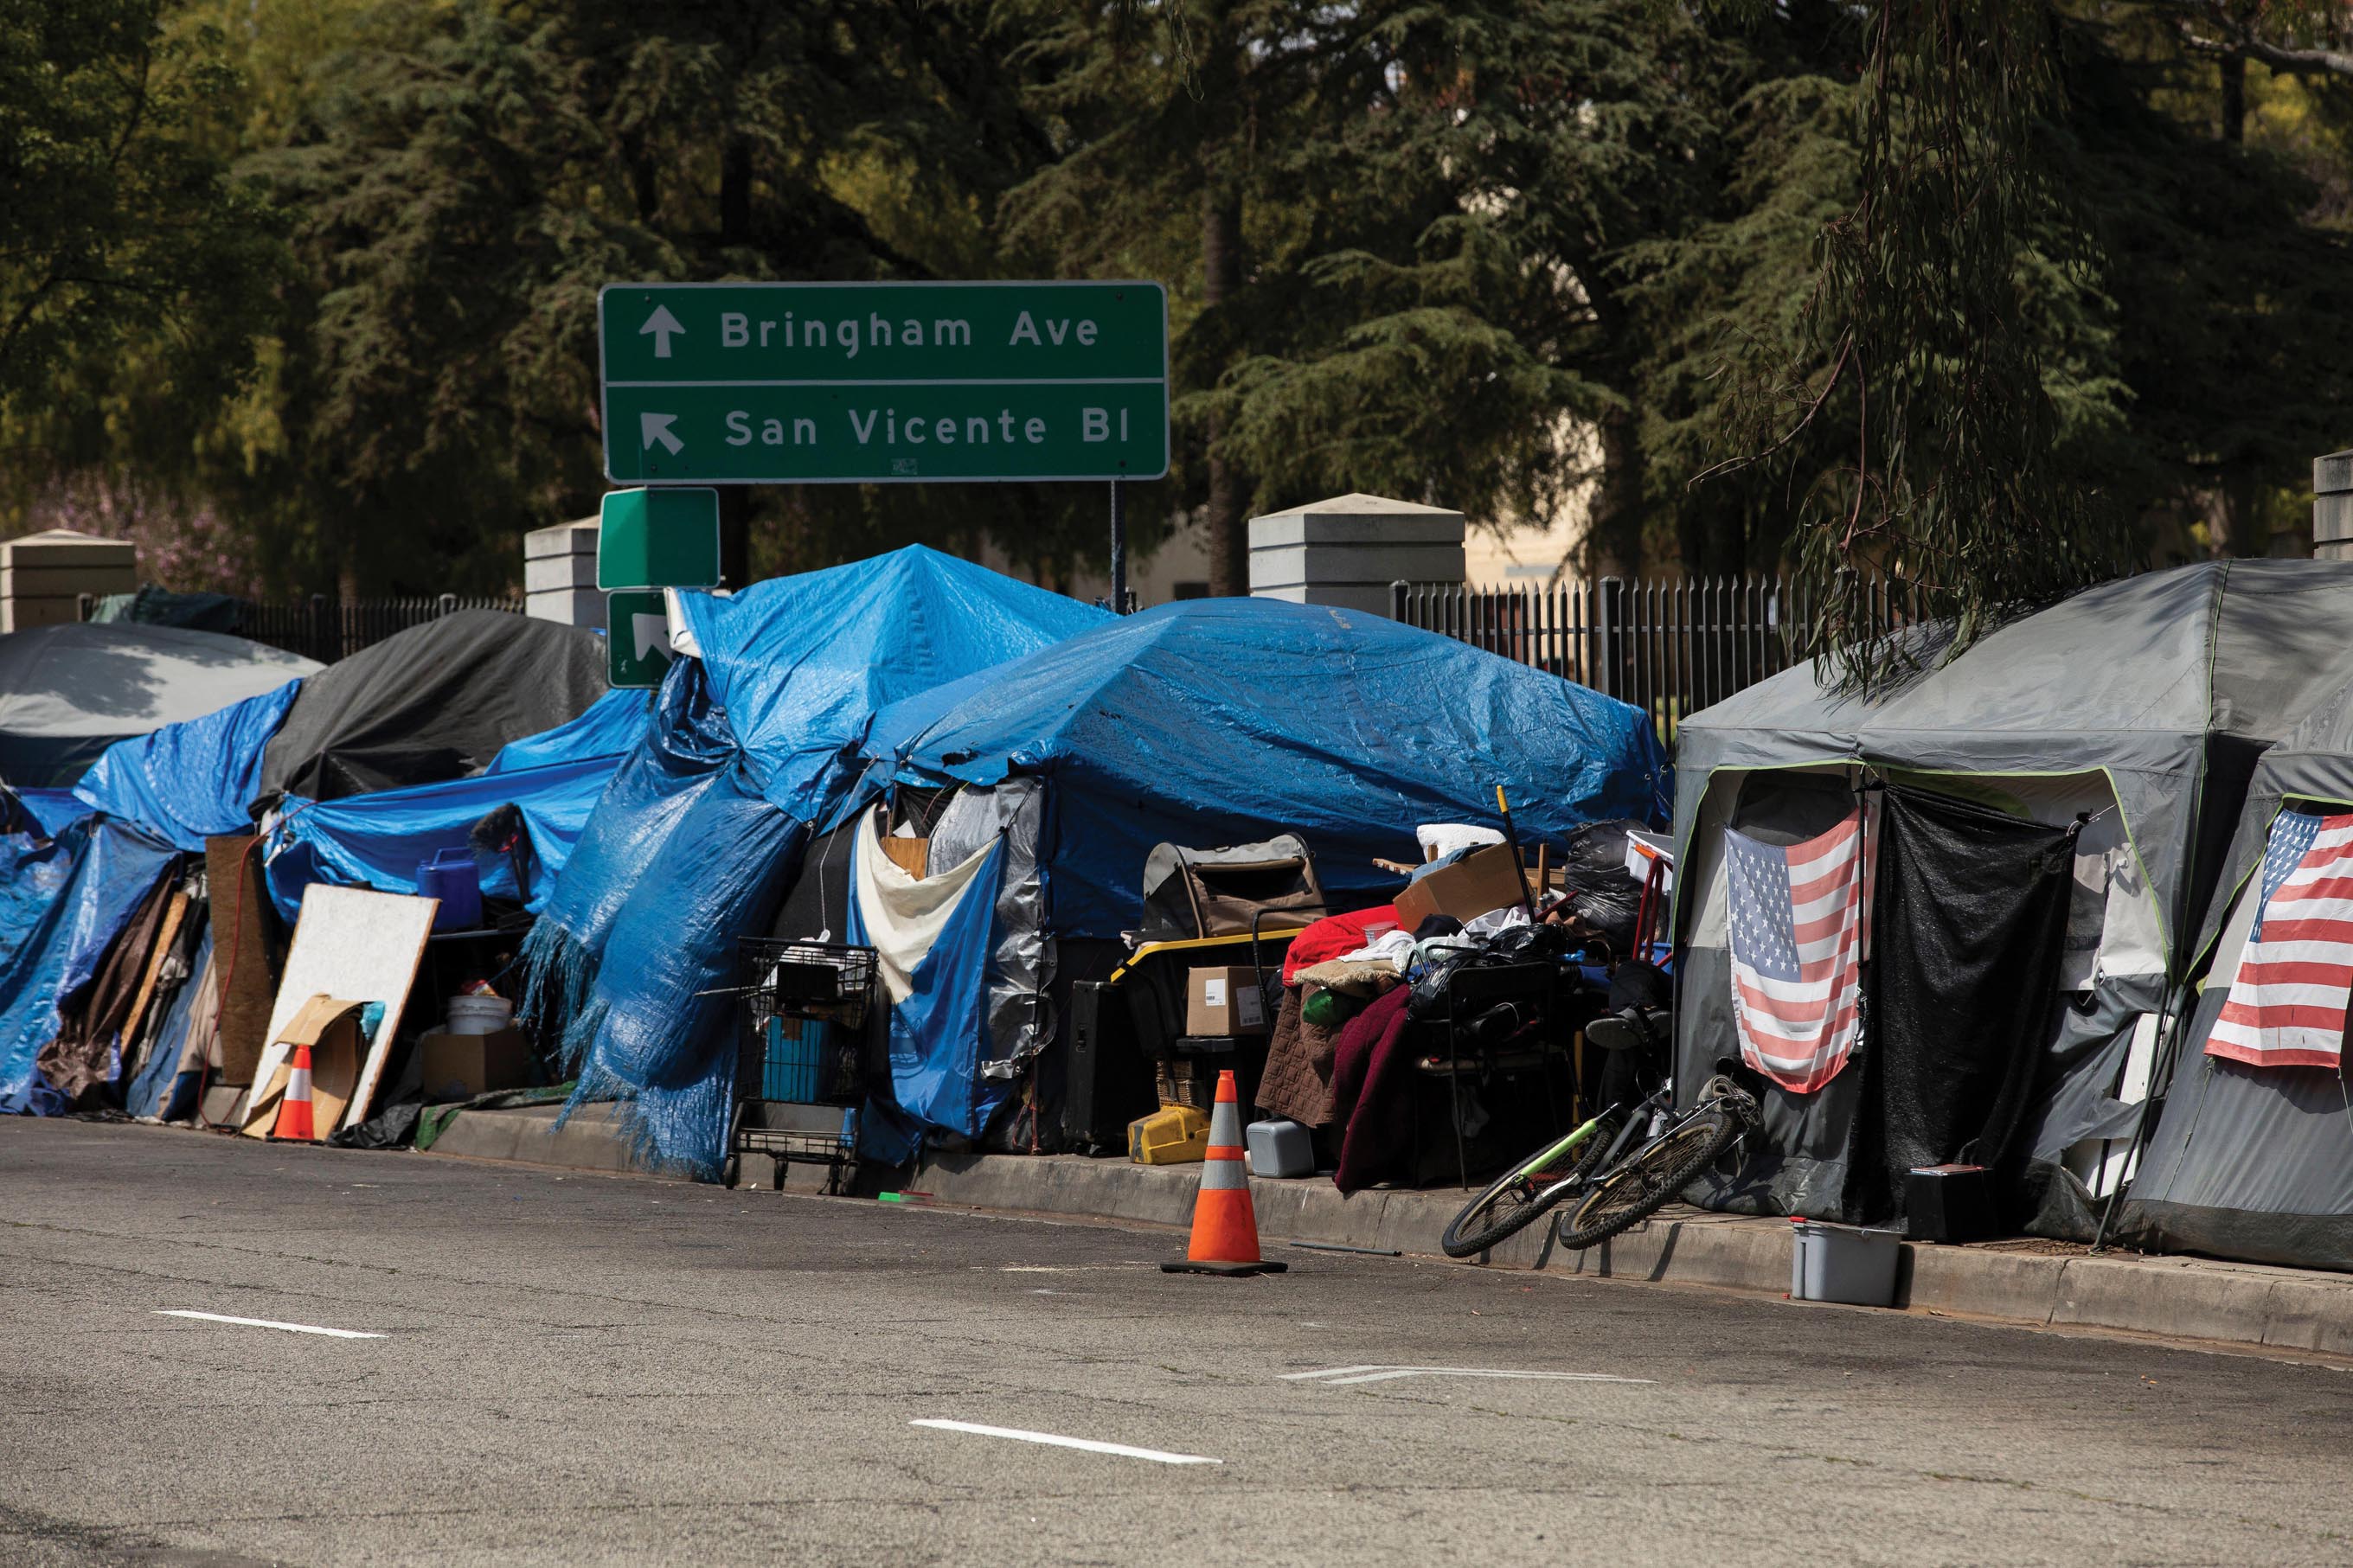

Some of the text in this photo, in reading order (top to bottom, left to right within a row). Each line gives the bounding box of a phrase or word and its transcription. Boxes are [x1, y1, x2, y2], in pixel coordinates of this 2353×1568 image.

[721, 310, 1098, 359] Bringham Ave
[725, 407, 1127, 445] San Vicente Bl
